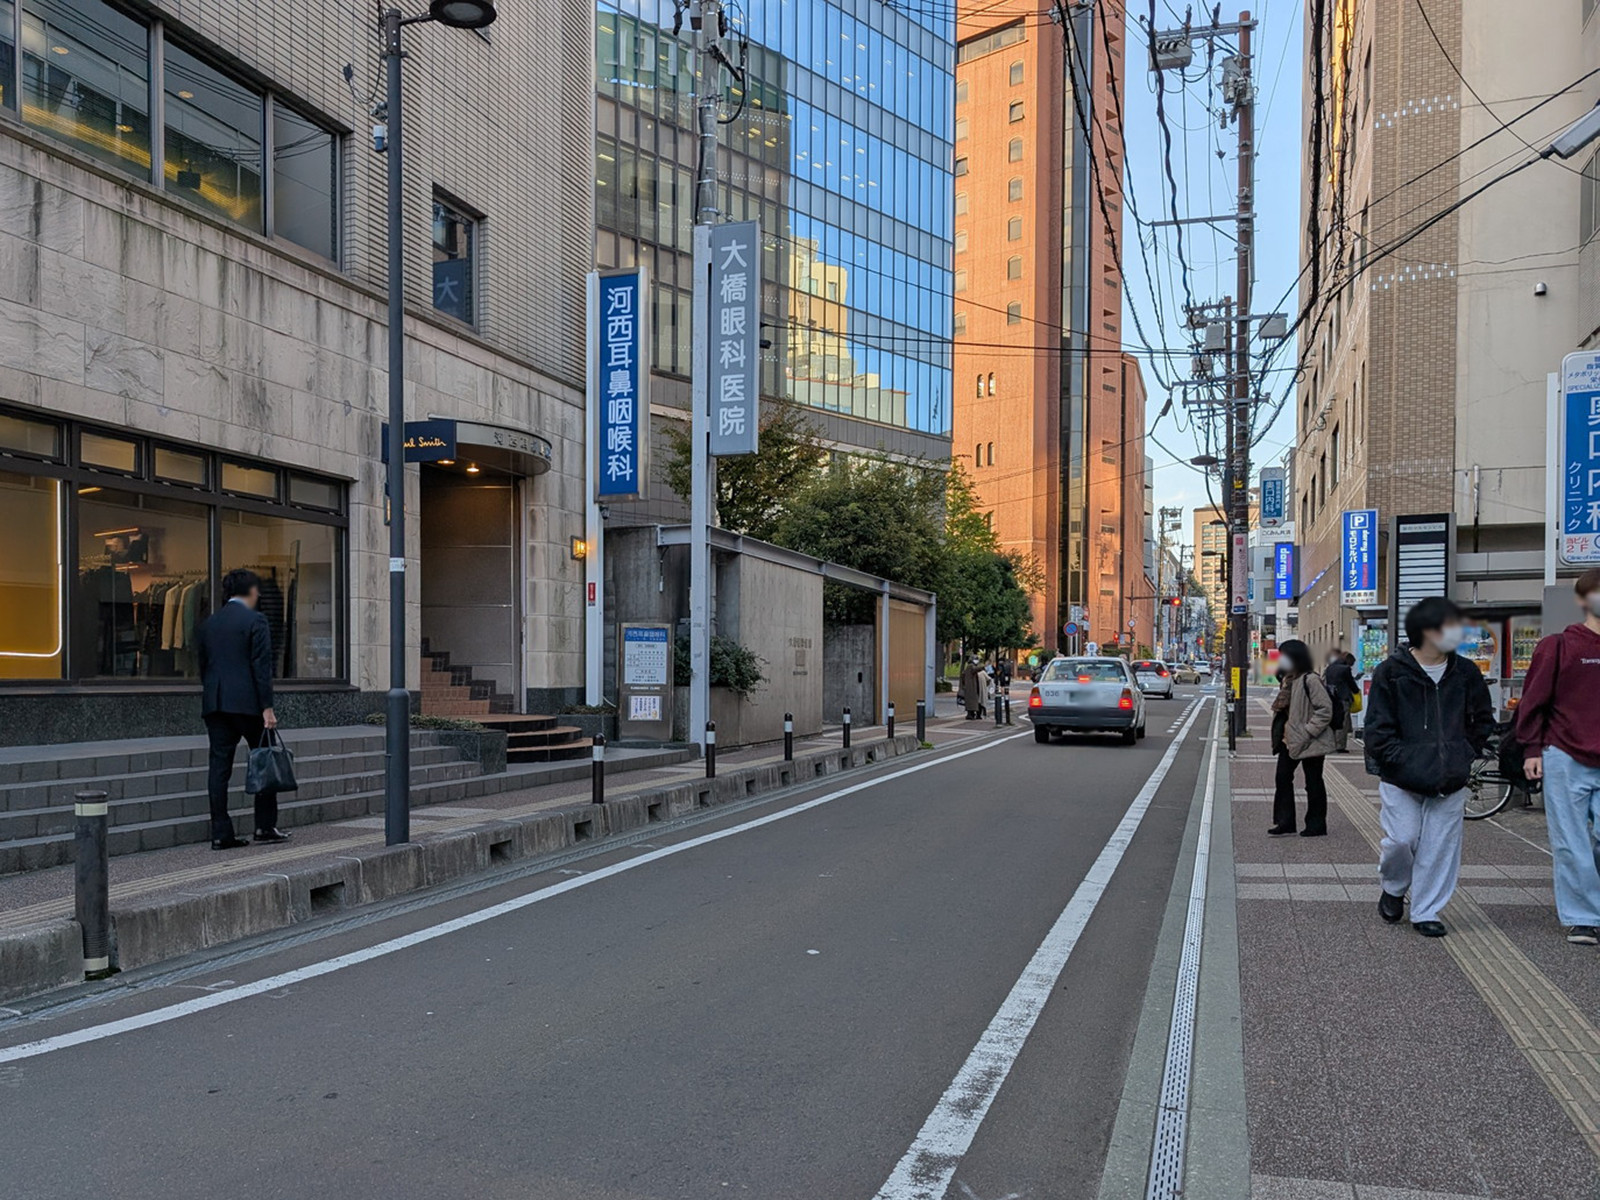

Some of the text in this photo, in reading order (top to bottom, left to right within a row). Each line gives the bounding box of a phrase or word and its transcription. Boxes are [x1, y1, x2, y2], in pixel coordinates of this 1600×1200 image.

[719, 240, 747, 436] 大橋眼科医院
[607, 286, 633, 482] 河西耳鼻咽喉科
[418, 436, 448, 448] Smith
[1354, 516, 1364, 527] P
[1567, 461, 1583, 531] クリニック
[1276, 547, 1290, 579] dormy
